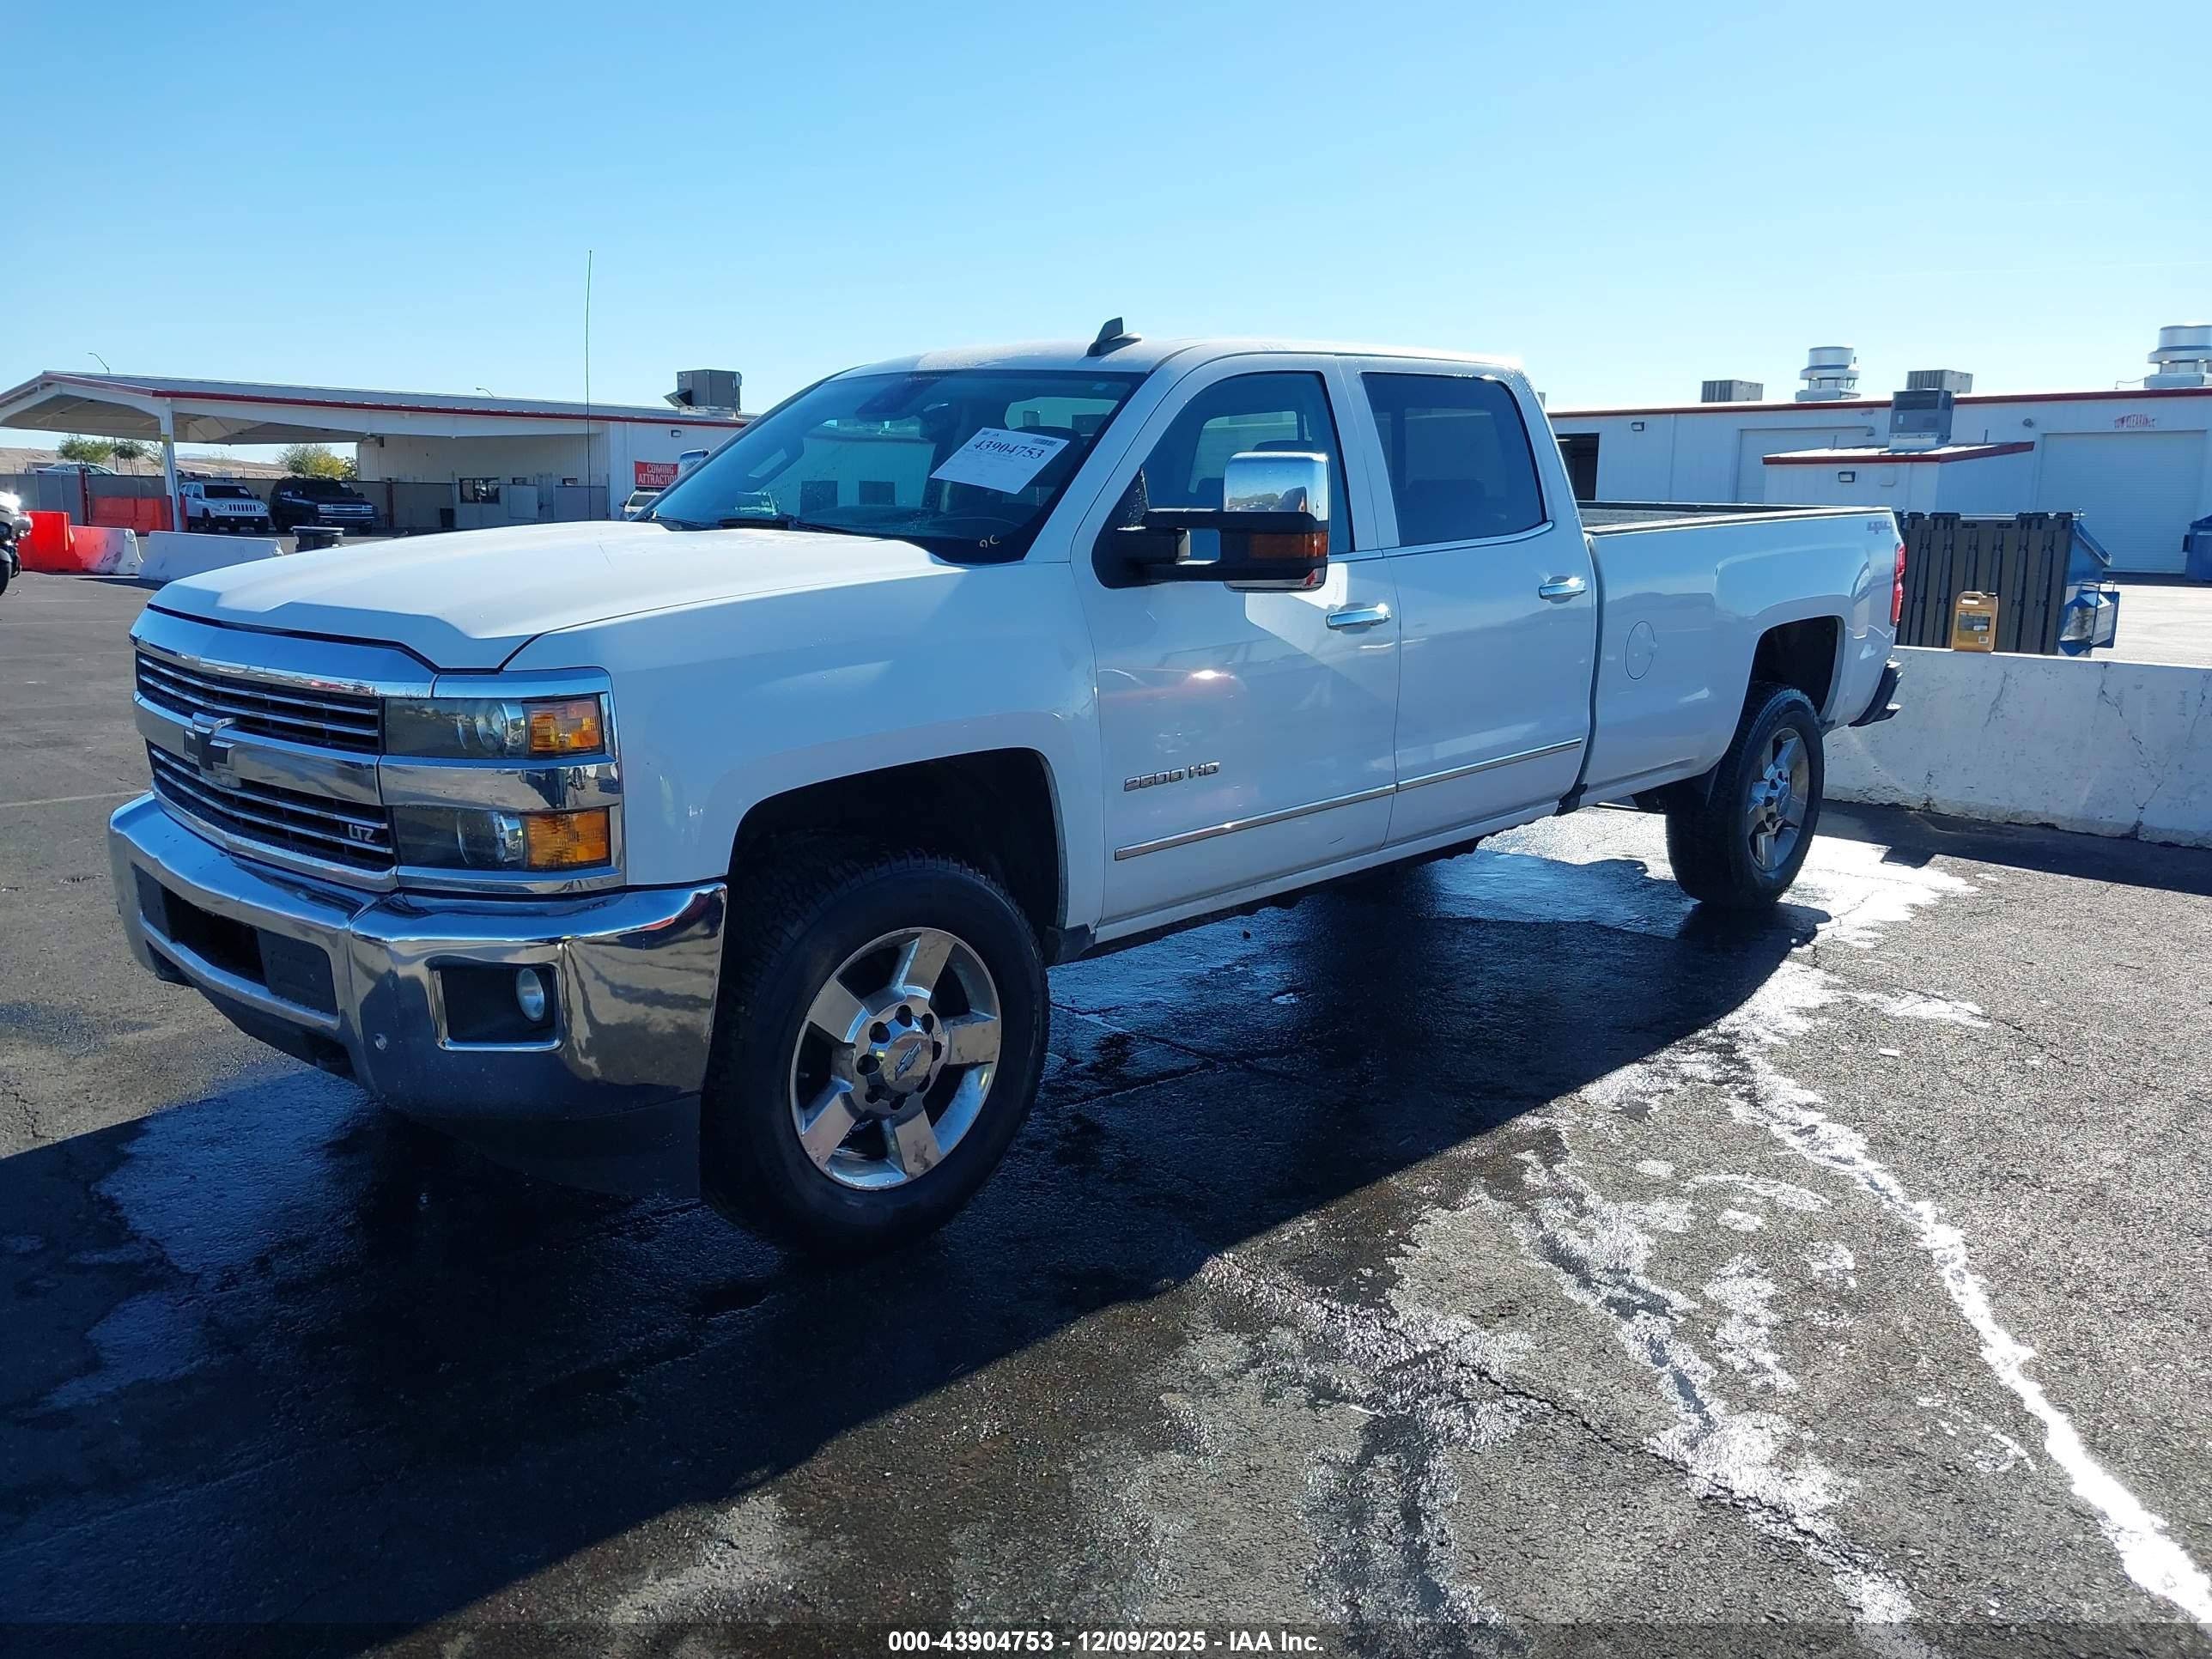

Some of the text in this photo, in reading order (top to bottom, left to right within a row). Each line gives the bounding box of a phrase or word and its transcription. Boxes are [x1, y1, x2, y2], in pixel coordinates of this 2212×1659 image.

[974, 440, 1045, 459] 43904753
[647, 464, 674, 475] COMING
[1124, 761, 1220, 792] 2500 HD
[348, 823, 376, 843] LTZ
